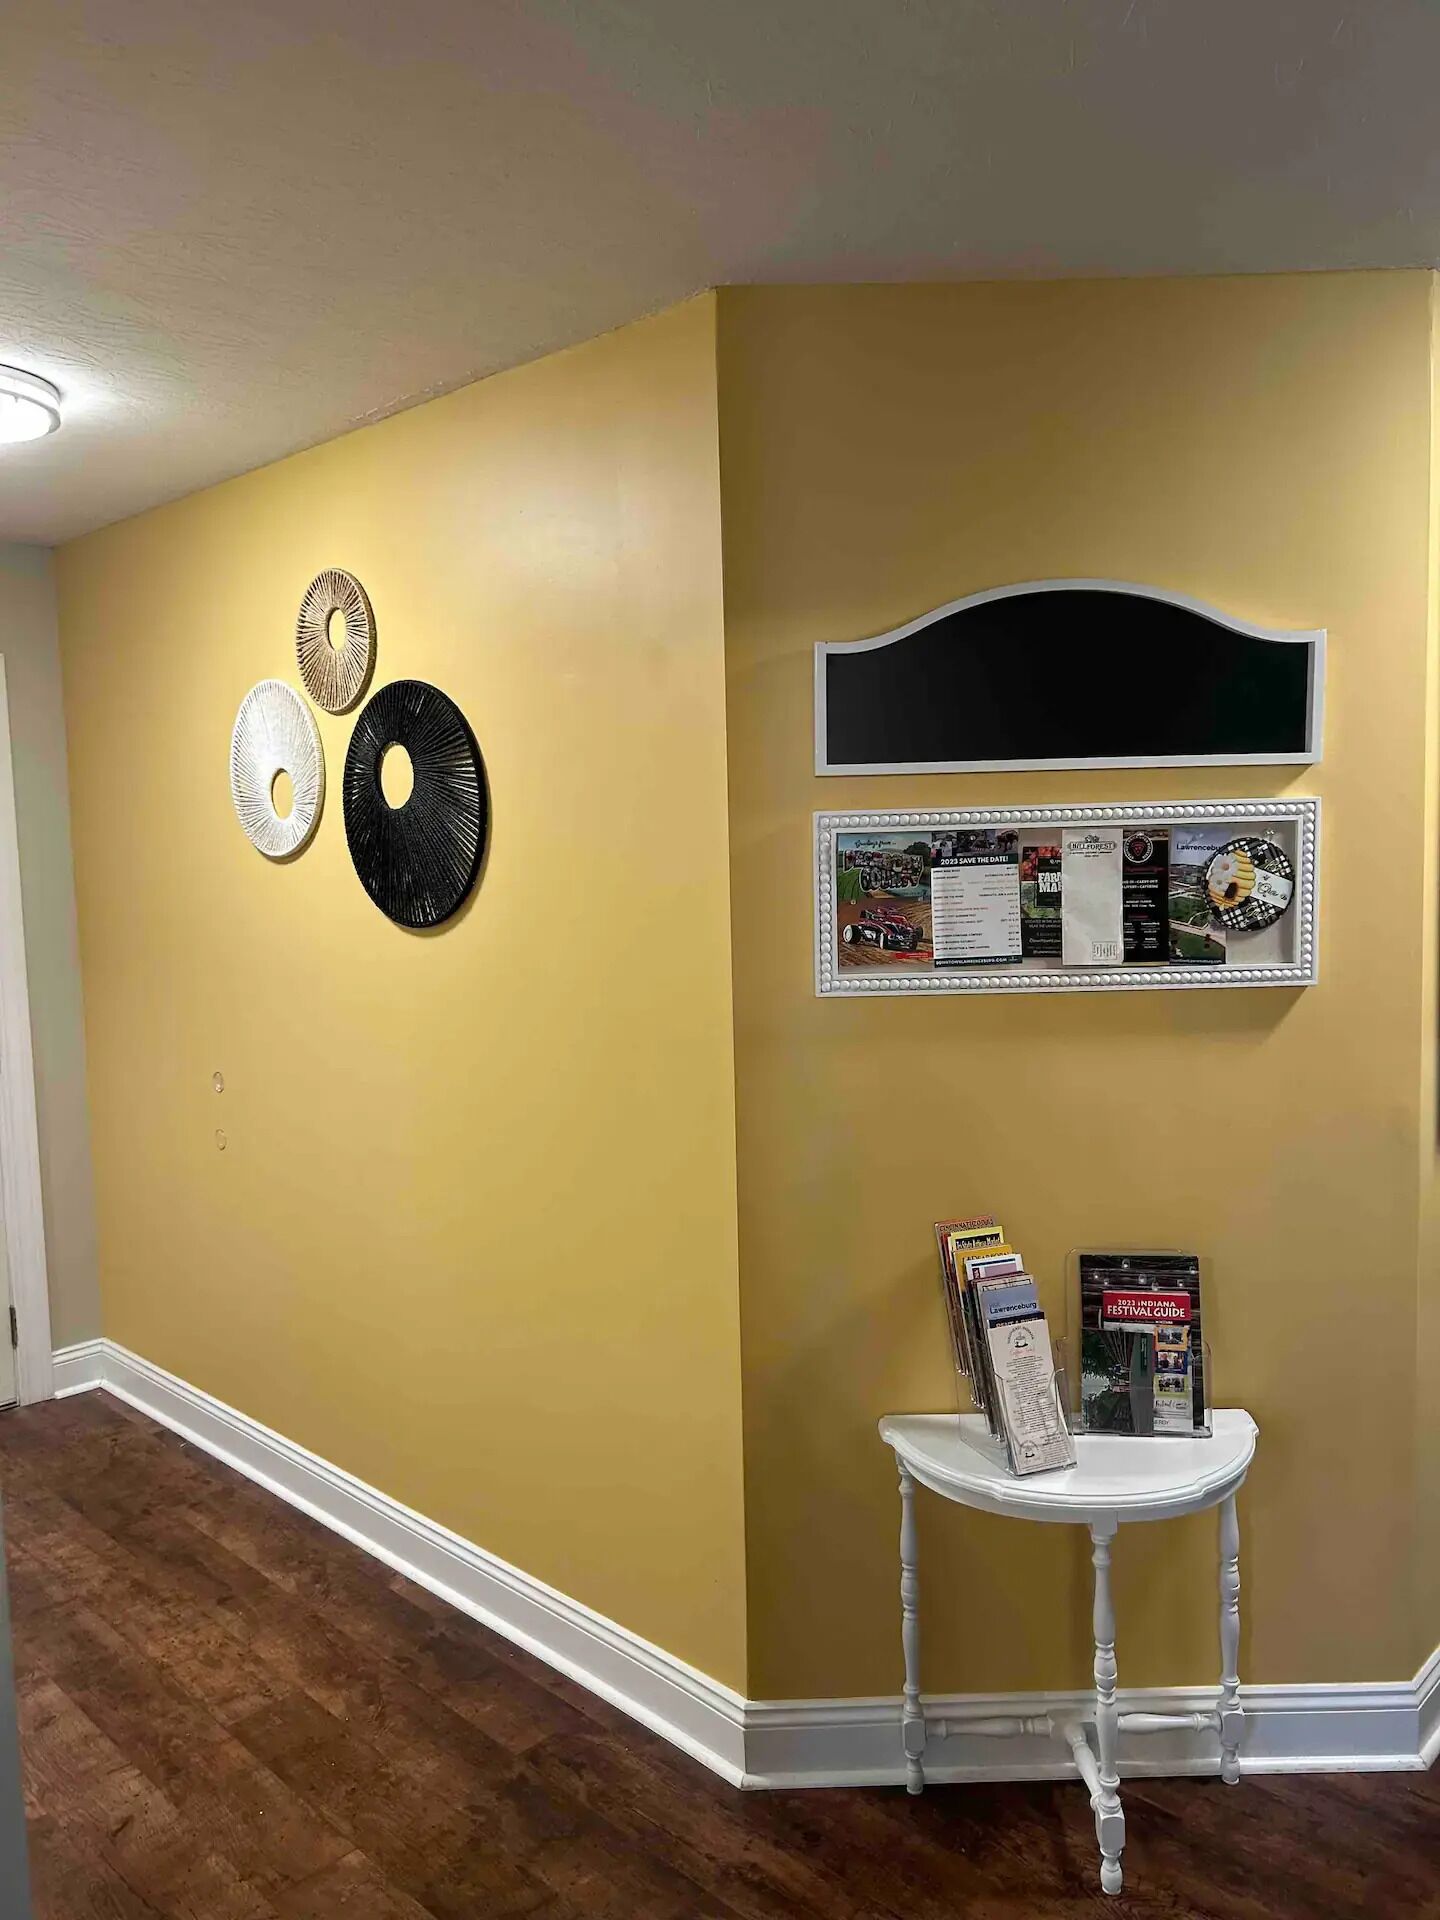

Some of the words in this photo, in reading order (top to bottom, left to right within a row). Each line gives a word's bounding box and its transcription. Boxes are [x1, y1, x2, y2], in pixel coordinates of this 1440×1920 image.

[1072, 842, 1113, 851] HILLFOREST
[959, 857, 976, 865] SAVE
[977, 856, 989, 864] THE
[990, 855, 1009, 863] DATE!
[990, 1302, 1037, 1314] Lawrenceburg
[1137, 1300, 1176, 1308] INDIANA
[1107, 1305, 1153, 1316] FESTIVAL
[1153, 1307, 1185, 1318] GUIDE
